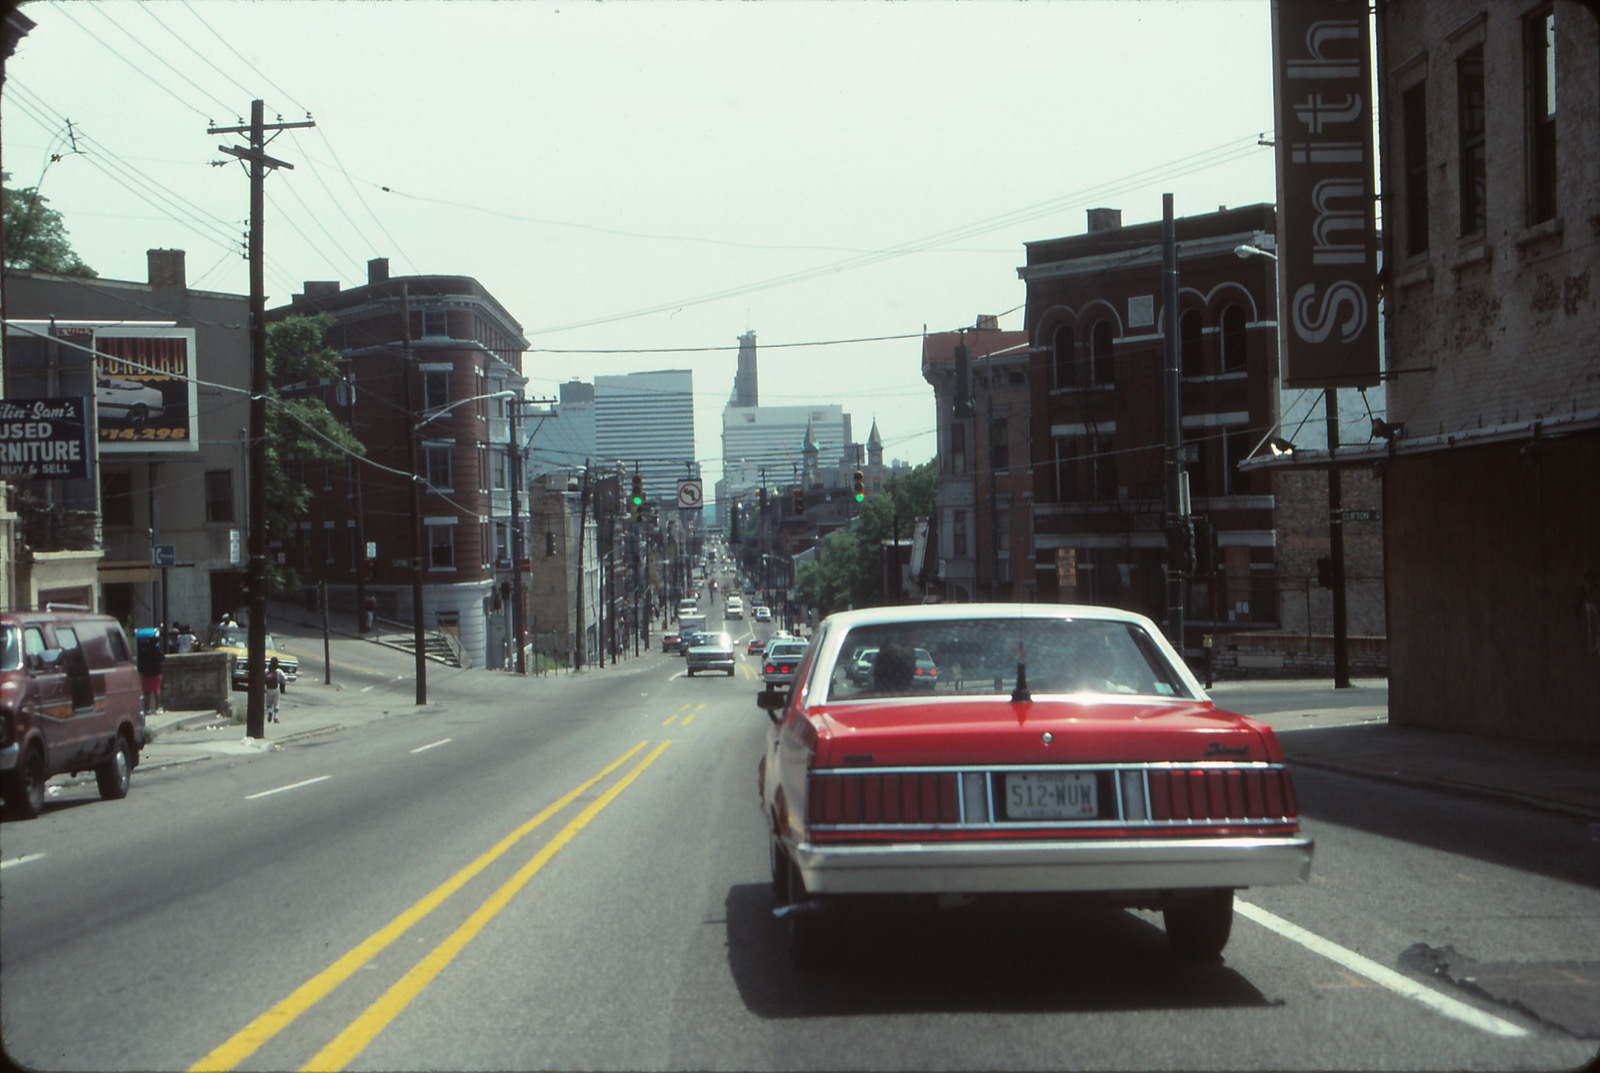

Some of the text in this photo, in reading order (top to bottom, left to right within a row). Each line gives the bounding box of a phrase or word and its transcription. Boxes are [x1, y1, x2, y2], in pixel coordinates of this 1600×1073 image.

[1287, 19, 1368, 345] Smith
[30, 401, 76, 419] Sam's
[1, 464, 70, 474] BUY & SELL
